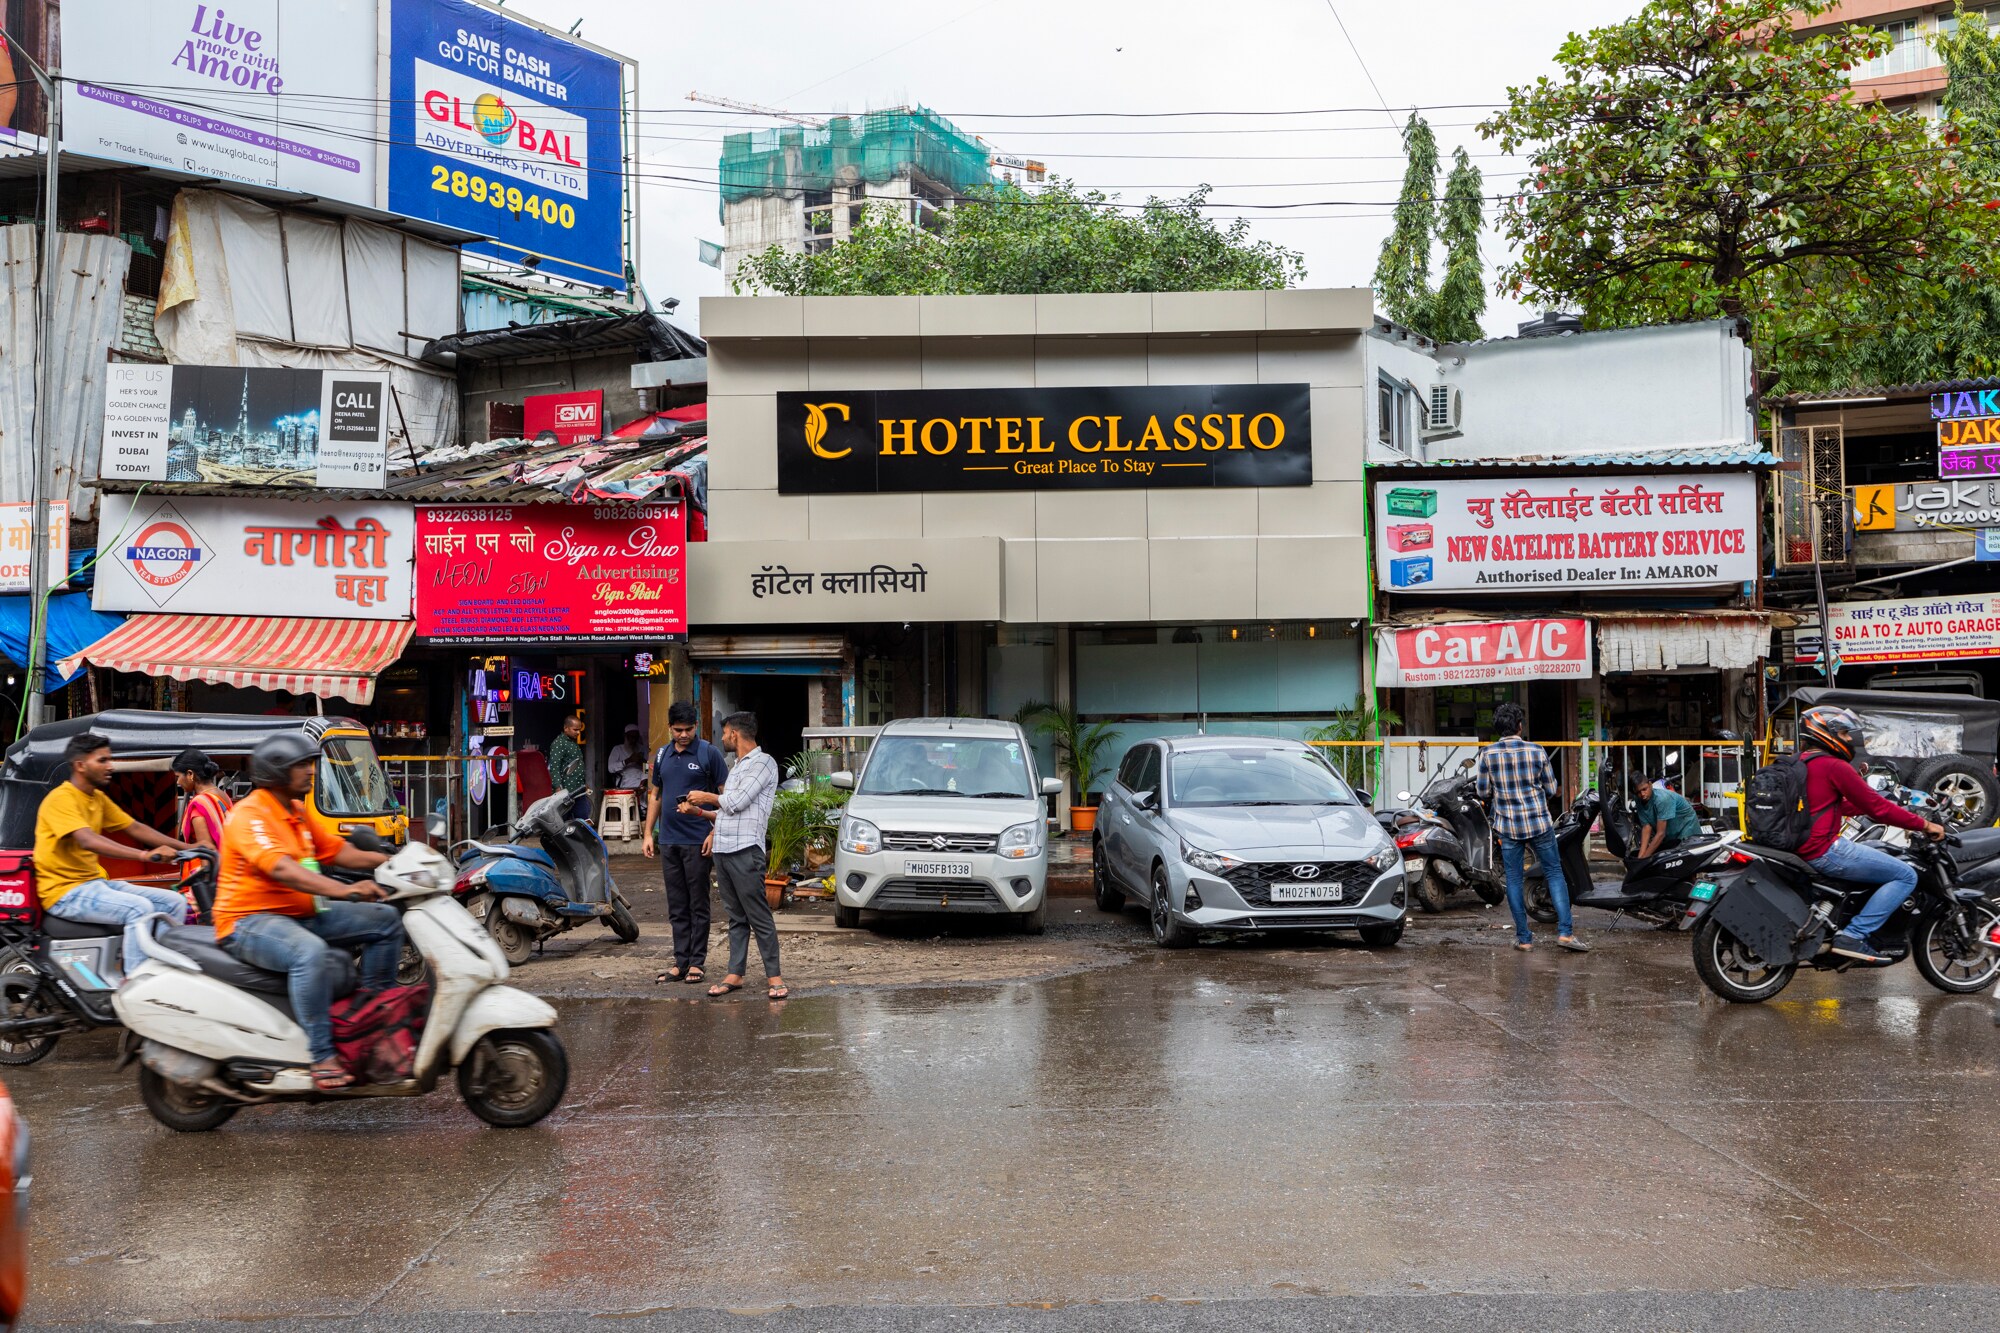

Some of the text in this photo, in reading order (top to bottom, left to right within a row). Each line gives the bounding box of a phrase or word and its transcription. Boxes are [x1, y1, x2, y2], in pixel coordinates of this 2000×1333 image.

[191, 4, 262, 51] Live
[196, 39, 280, 74] more with
[456, 28, 551, 78] SAVE CASH
[171, 40, 284, 96] Amore
[438, 41, 567, 101] GO FOR BARTER
[91, 87, 356, 169] PANTIES BOYLEG SLIPS CAMISOLE RACER BACK SHORTIES
[98, 138, 175, 165] For Trade Enquiries,
[191, 138, 278, 168] www.luxglobal.co.in
[425, 131, 582, 191] ADVERTISERS PVT. LTD.
[211, 167, 230, 179] 97871
[431, 165, 576, 229] 28939400
[139, 402, 167, 410] CHANCE
[335, 392, 375, 409] CALL
[559, 405, 594, 421] GM
[111, 430, 159, 439] INVEST IN
[878, 412, 1286, 456] HOTEL CLASSIO
[119, 447, 149, 456] DUBAI
[1942, 451, 1977, 472] जैक
[116, 464, 150, 473] TODAY!
[1014, 459, 1156, 475] Great Place To Stay
[427, 509, 513, 523] 9322638125
[593, 507, 680, 521] 9082660514
[1466, 498, 1495, 529] न्यु
[1658, 484, 1725, 515] सर्विस
[244, 515, 391, 568] नागौरी
[424, 526, 537, 557] साईन एन ग्लो
[543, 525, 679, 566] Sign n Glow
[1447, 528, 1746, 563] NEW SATELITE BATTERY SERVICE
[136, 548, 192, 560] NAGORI
[137, 567, 188, 584] TEA STATION
[433, 558, 493, 588] NEON
[576, 563, 680, 584] Advertising
[751, 563, 928, 598] हॉटेल क्लासियो
[1475, 565, 1718, 584] Authorised Dealer In: AMARON
[334, 574, 389, 607] चहा
[591, 581, 663, 606] Sign Point
[594, 608, 674, 616] snglow2000@gmail.com
[1850, 607, 1874, 621] साई
[1877, 608, 1885, 620] ए
[1835, 617, 2000, 640] SAI A TO Z AUTO GARAGE
[1415, 621, 1568, 665] Car A/C
[1884, 638, 1900, 646] Body
[1405, 672, 1436, 682] Rustom
[1443, 669, 1496, 681] 9821223789
[1504, 665, 1525, 676] Altaf
[911, 863, 970, 874] MH05FB1338
[1665, 859, 1683, 869] DIO
[1279, 886, 1340, 898] MH02FN0758
